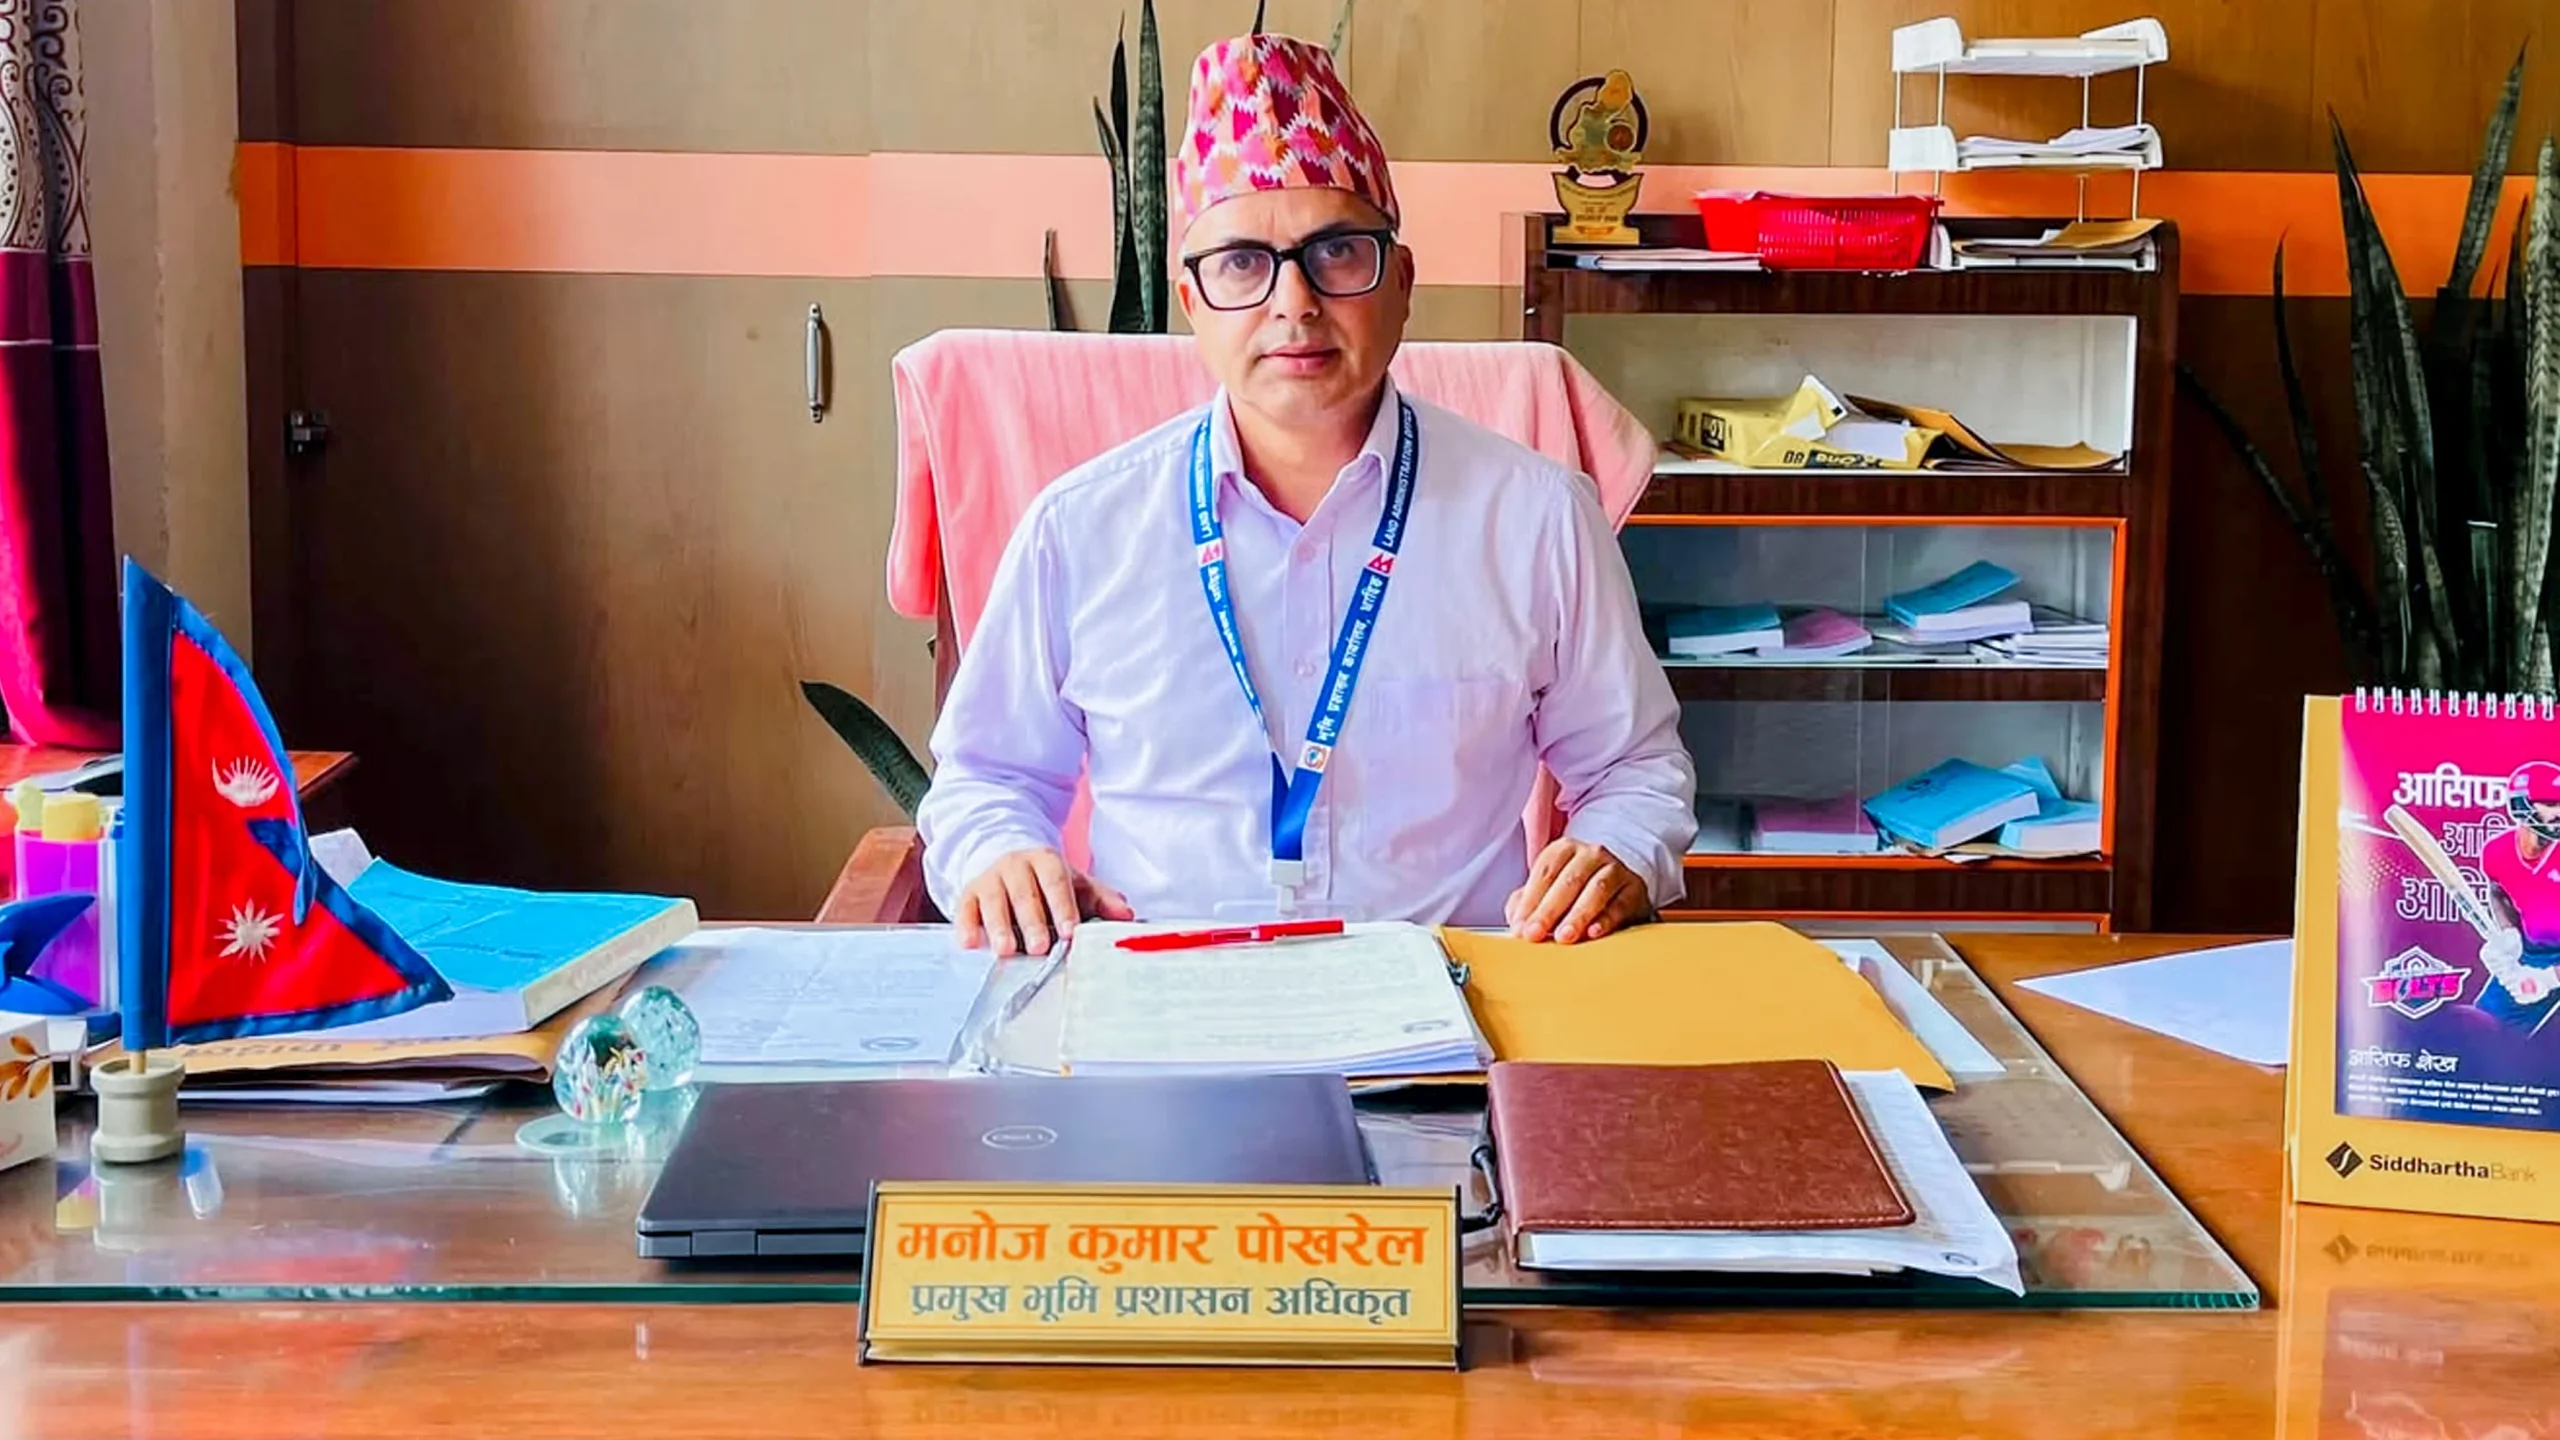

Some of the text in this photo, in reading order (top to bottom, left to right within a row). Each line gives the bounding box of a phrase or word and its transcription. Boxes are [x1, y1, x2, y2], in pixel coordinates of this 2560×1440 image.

[1382, 519, 1399, 547] LAND
[2393, 762, 2508, 809] आसिफ
[898, 1209, 1428, 1275] मनोज कुमार पोखरेल
[911, 1276, 1411, 1325] प्रमुख भूमि प्रशासन अधिकृत
